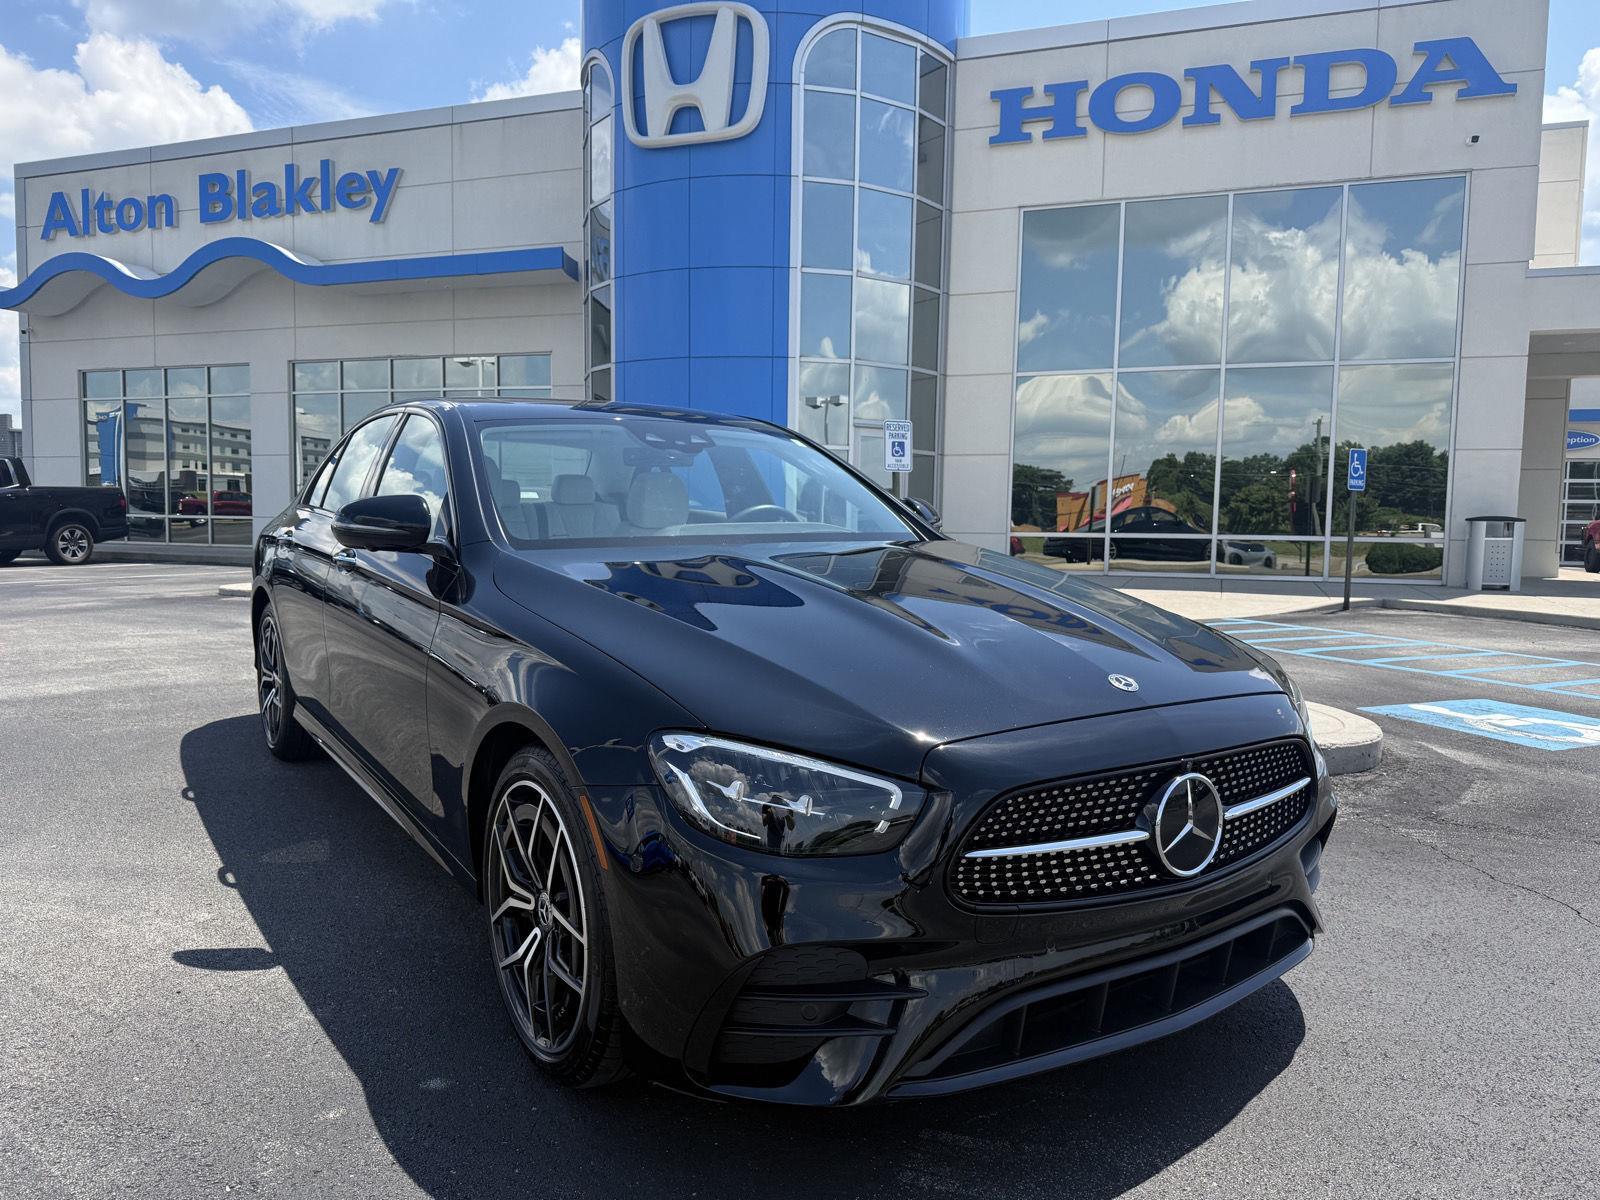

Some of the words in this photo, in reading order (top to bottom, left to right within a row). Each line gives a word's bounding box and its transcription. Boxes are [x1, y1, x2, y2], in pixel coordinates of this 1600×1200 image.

[989, 36, 1518, 146] HONDA
[40, 188, 177, 241] Alton
[198, 158, 402, 224] Blakley
[886, 423, 910, 432] RESERVED
[888, 432, 908, 440] PARKING
